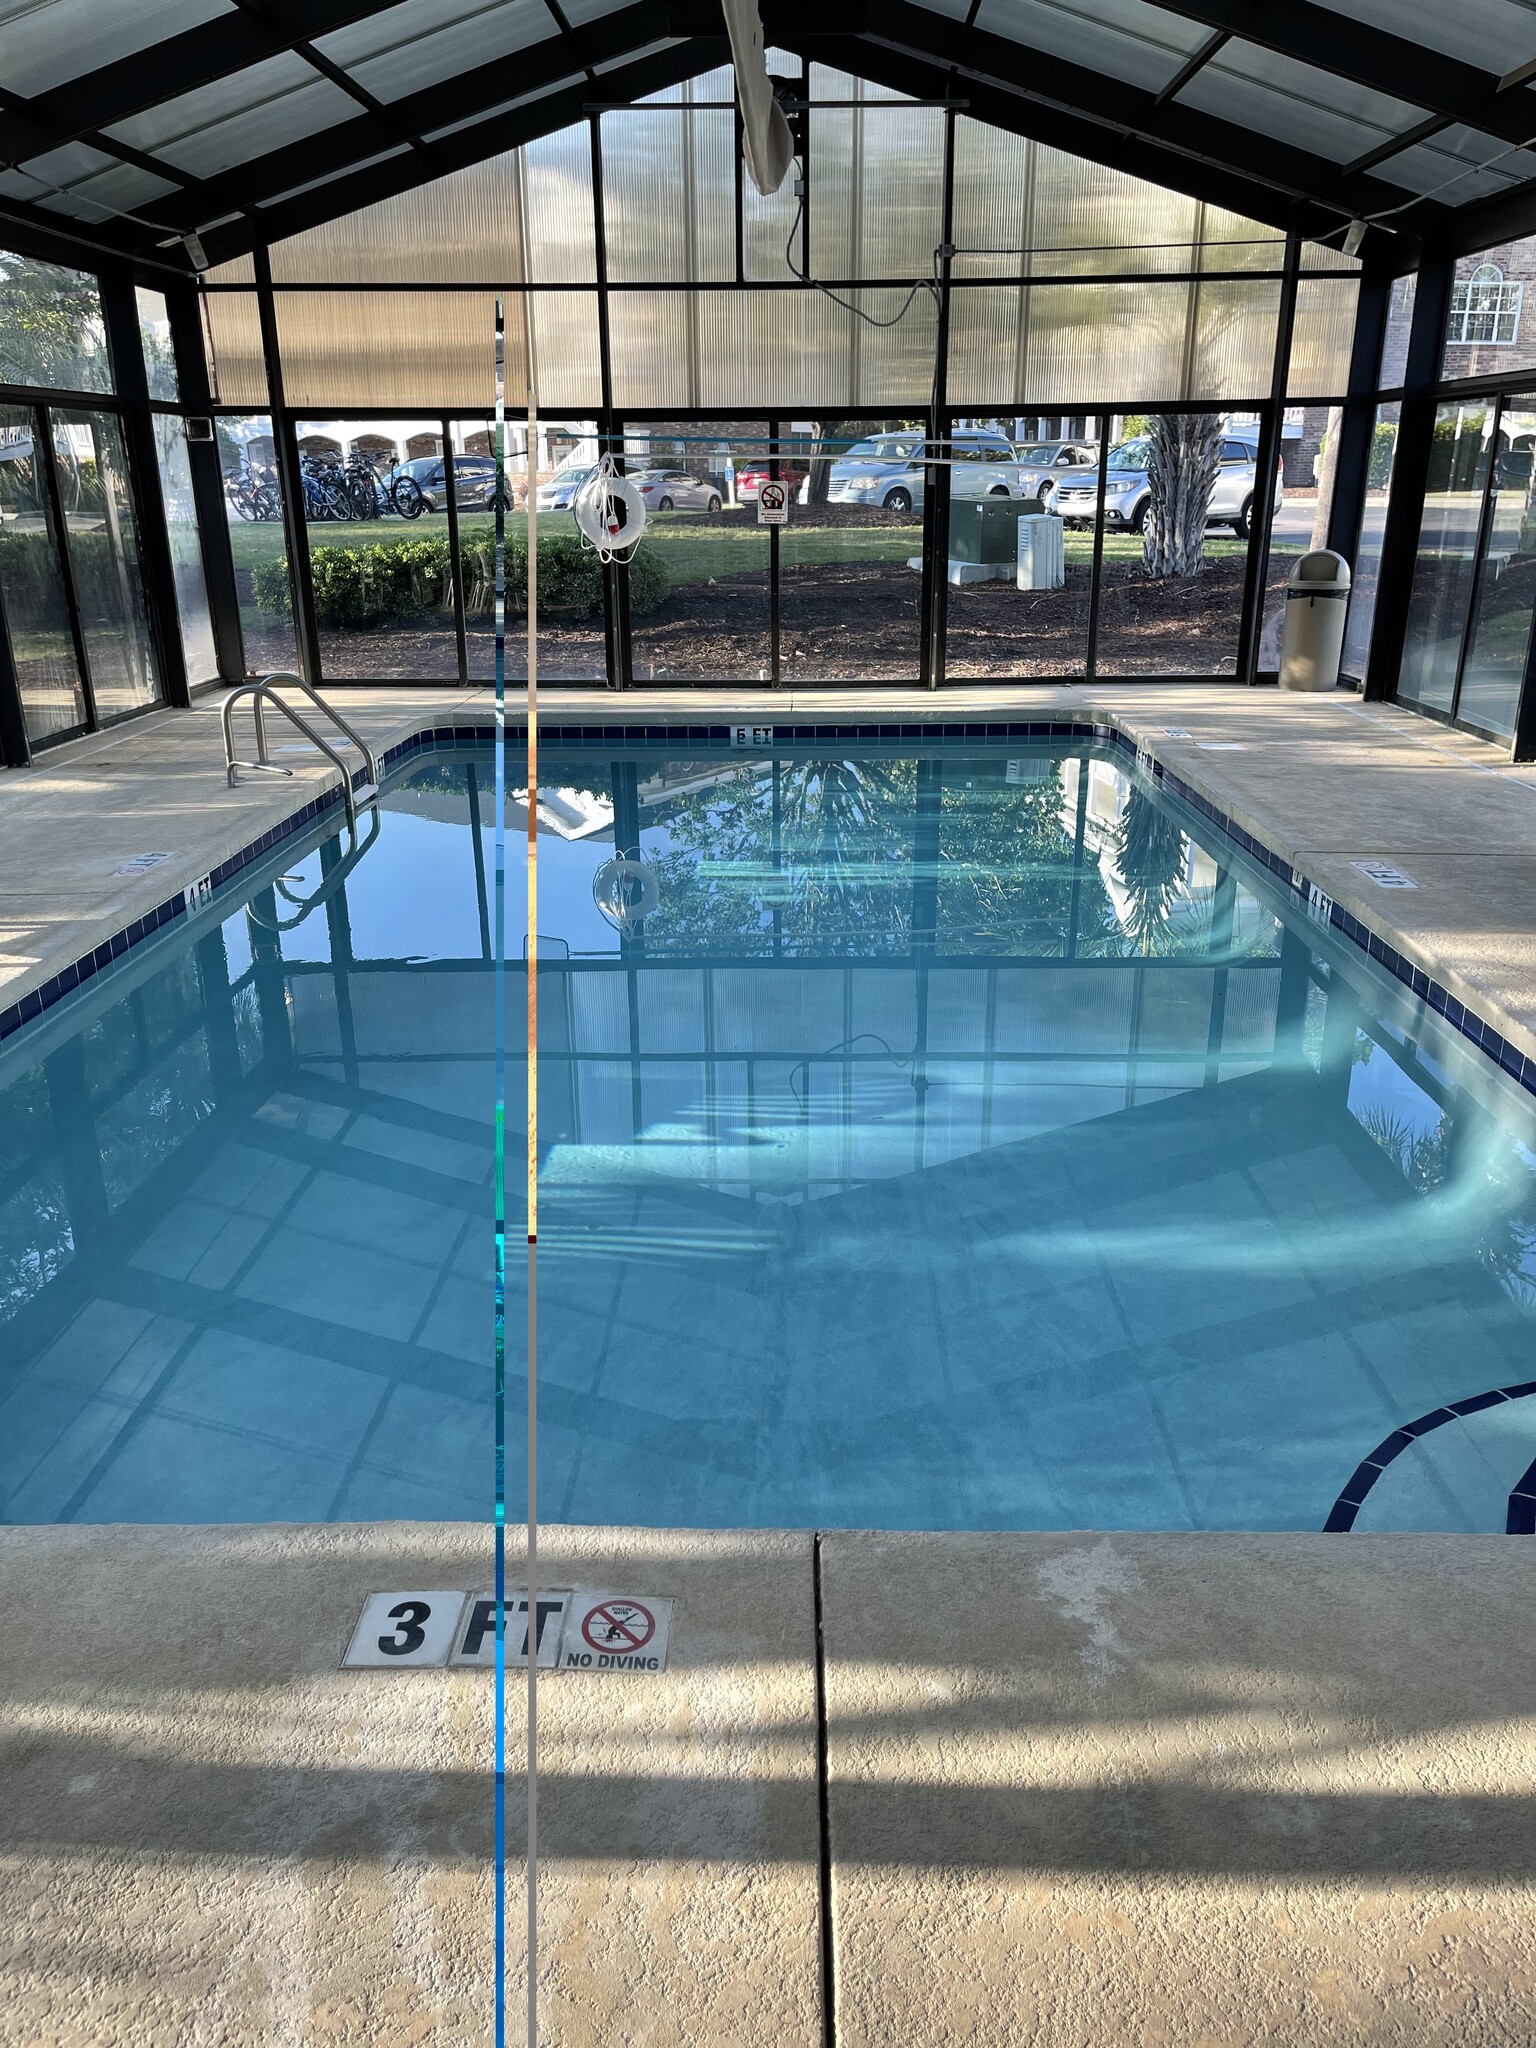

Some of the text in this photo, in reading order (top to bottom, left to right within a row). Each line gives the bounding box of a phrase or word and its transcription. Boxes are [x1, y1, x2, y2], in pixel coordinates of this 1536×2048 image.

[1366, 869, 1401, 878] FT
[1311, 890, 1332, 914] 4 FT
[377, 1601, 563, 1656] 3 FT
[566, 1653, 659, 1671] NO DIVING
